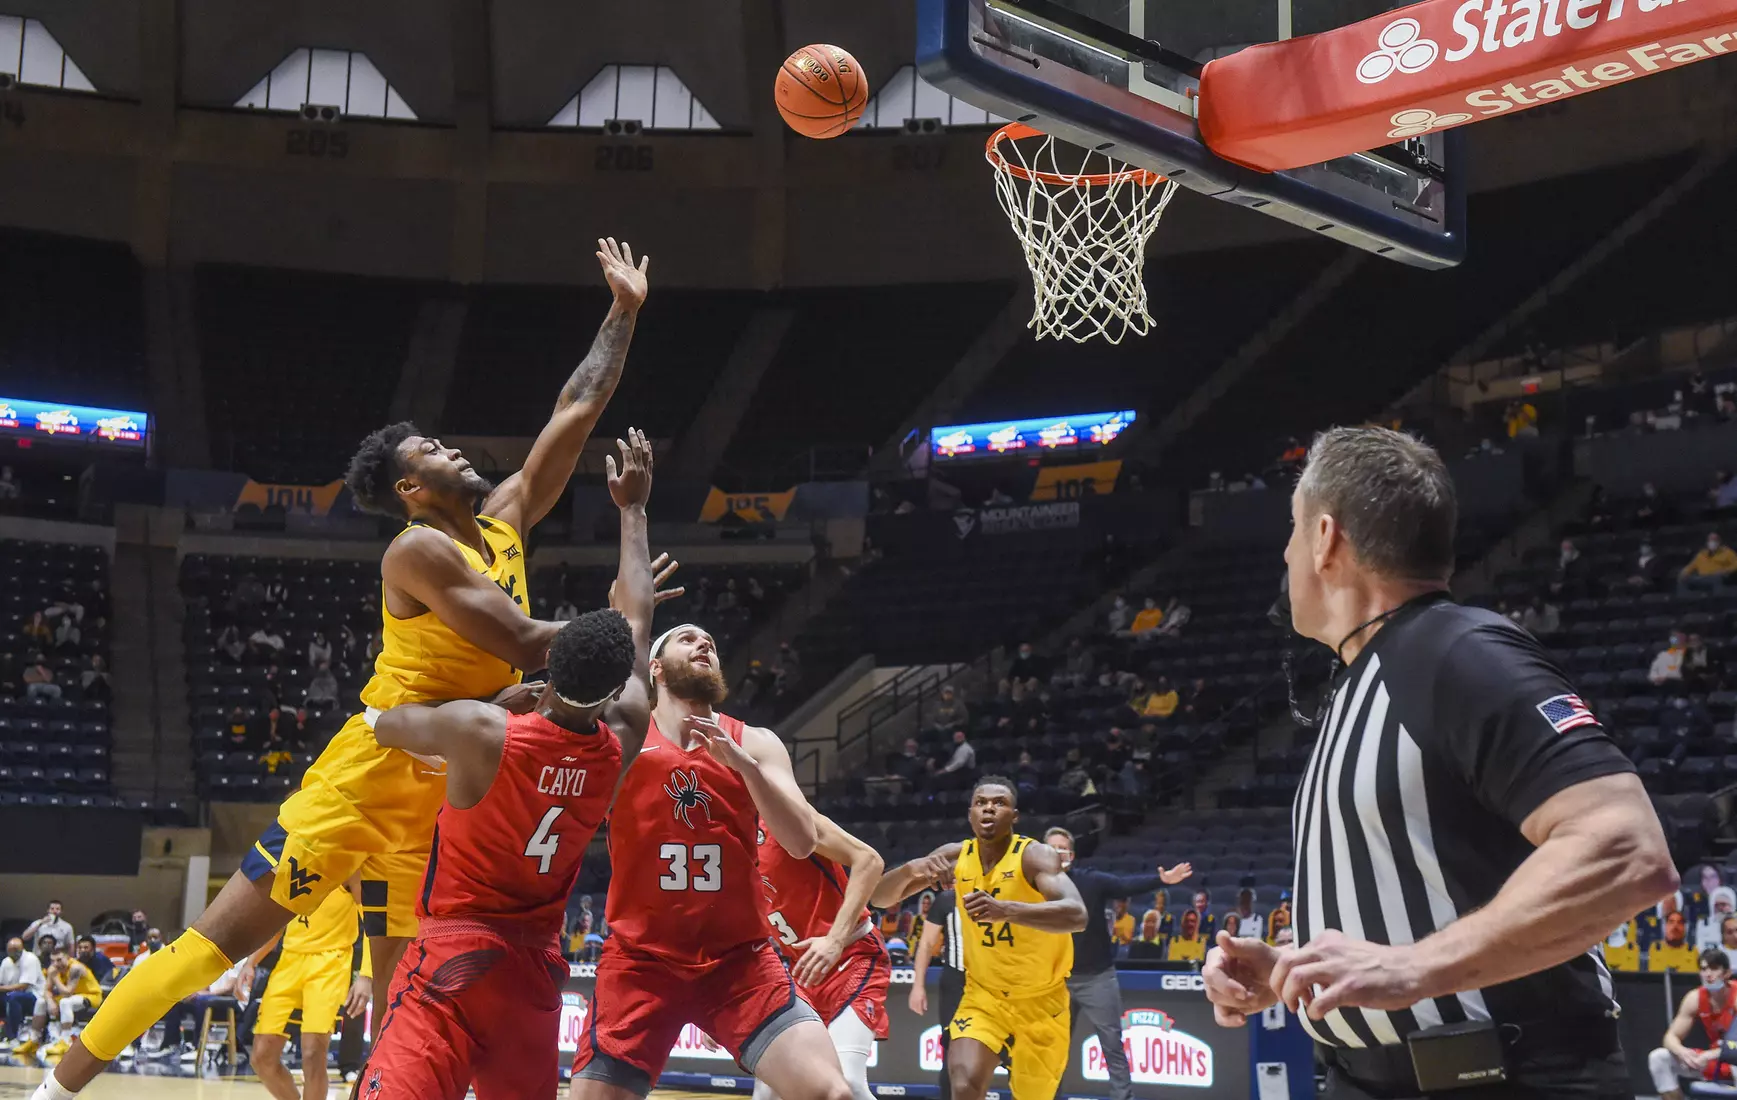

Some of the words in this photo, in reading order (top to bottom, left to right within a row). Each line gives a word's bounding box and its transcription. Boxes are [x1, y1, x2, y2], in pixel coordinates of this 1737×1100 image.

[285, 129, 349, 158] 205
[595, 145, 654, 172] 206
[537, 765, 587, 797] CAYO
[524, 805, 565, 874] 4
[659, 843, 722, 891] 33
[767, 910, 799, 946] 3
[977, 921, 1014, 948] 34
[1161, 974, 1205, 991] GEIC
[1131, 1011, 1160, 1025] PIZZA
[1139, 1037, 1206, 1077] JOHN'S
